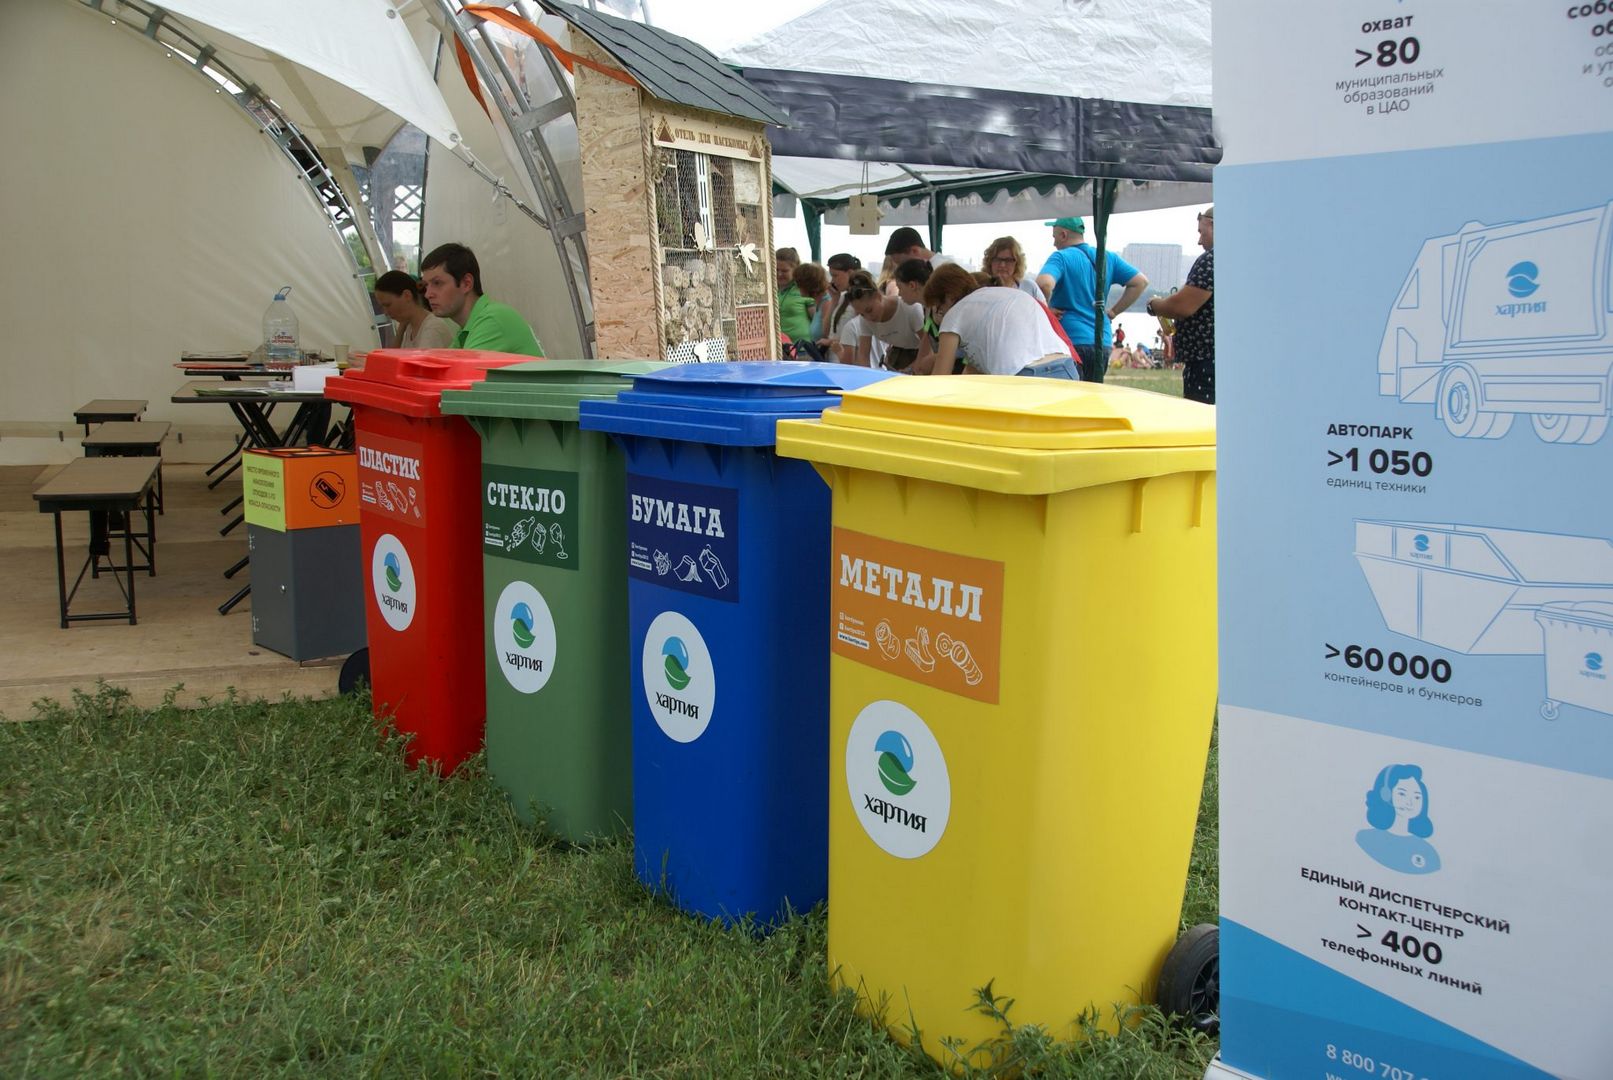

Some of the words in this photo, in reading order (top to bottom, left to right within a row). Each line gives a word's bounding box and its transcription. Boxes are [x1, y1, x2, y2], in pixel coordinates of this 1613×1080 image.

[1361, 15, 1415, 33] охват
[1355, 37, 1420, 67] >80
[1335, 68, 1444, 92] муниципальных
[1343, 83, 1434, 104] образований
[1366, 105, 1375, 115] в
[1378, 99, 1411, 114] ЦАО
[1327, 423, 1414, 440] АВТОПАРК
[359, 446, 420, 480] ПЛАСТИК
[487, 481, 566, 515] СТЕКЛО
[1326, 477, 1372, 490] единиц
[1376, 481, 1427, 494] техники
[631, 493, 725, 538] БУМАГА
[840, 553, 983, 622] МЕТАЛЛ
[382, 593, 408, 614] хартия
[505, 651, 543, 673] хартия
[1324, 671, 1404, 693] контейнеров
[1407, 686, 1415, 695] и
[1418, 686, 1483, 707] бункеров
[656, 691, 699, 720] хартия
[864, 793, 928, 833] хартия
[1301, 867, 1365, 895] ЕДИНЫЙ
[1368, 886, 1511, 935] ДИСПЕТЧЕРСКИЙ
[1338, 896, 1465, 940] КОНТАКТ-ЦЕНТР
[1320, 937, 1424, 977] телефонных
[1427, 971, 1483, 996] линий
[1326, 1044, 1337, 1060] 8
[1341, 1049, 1375, 1073] 800
